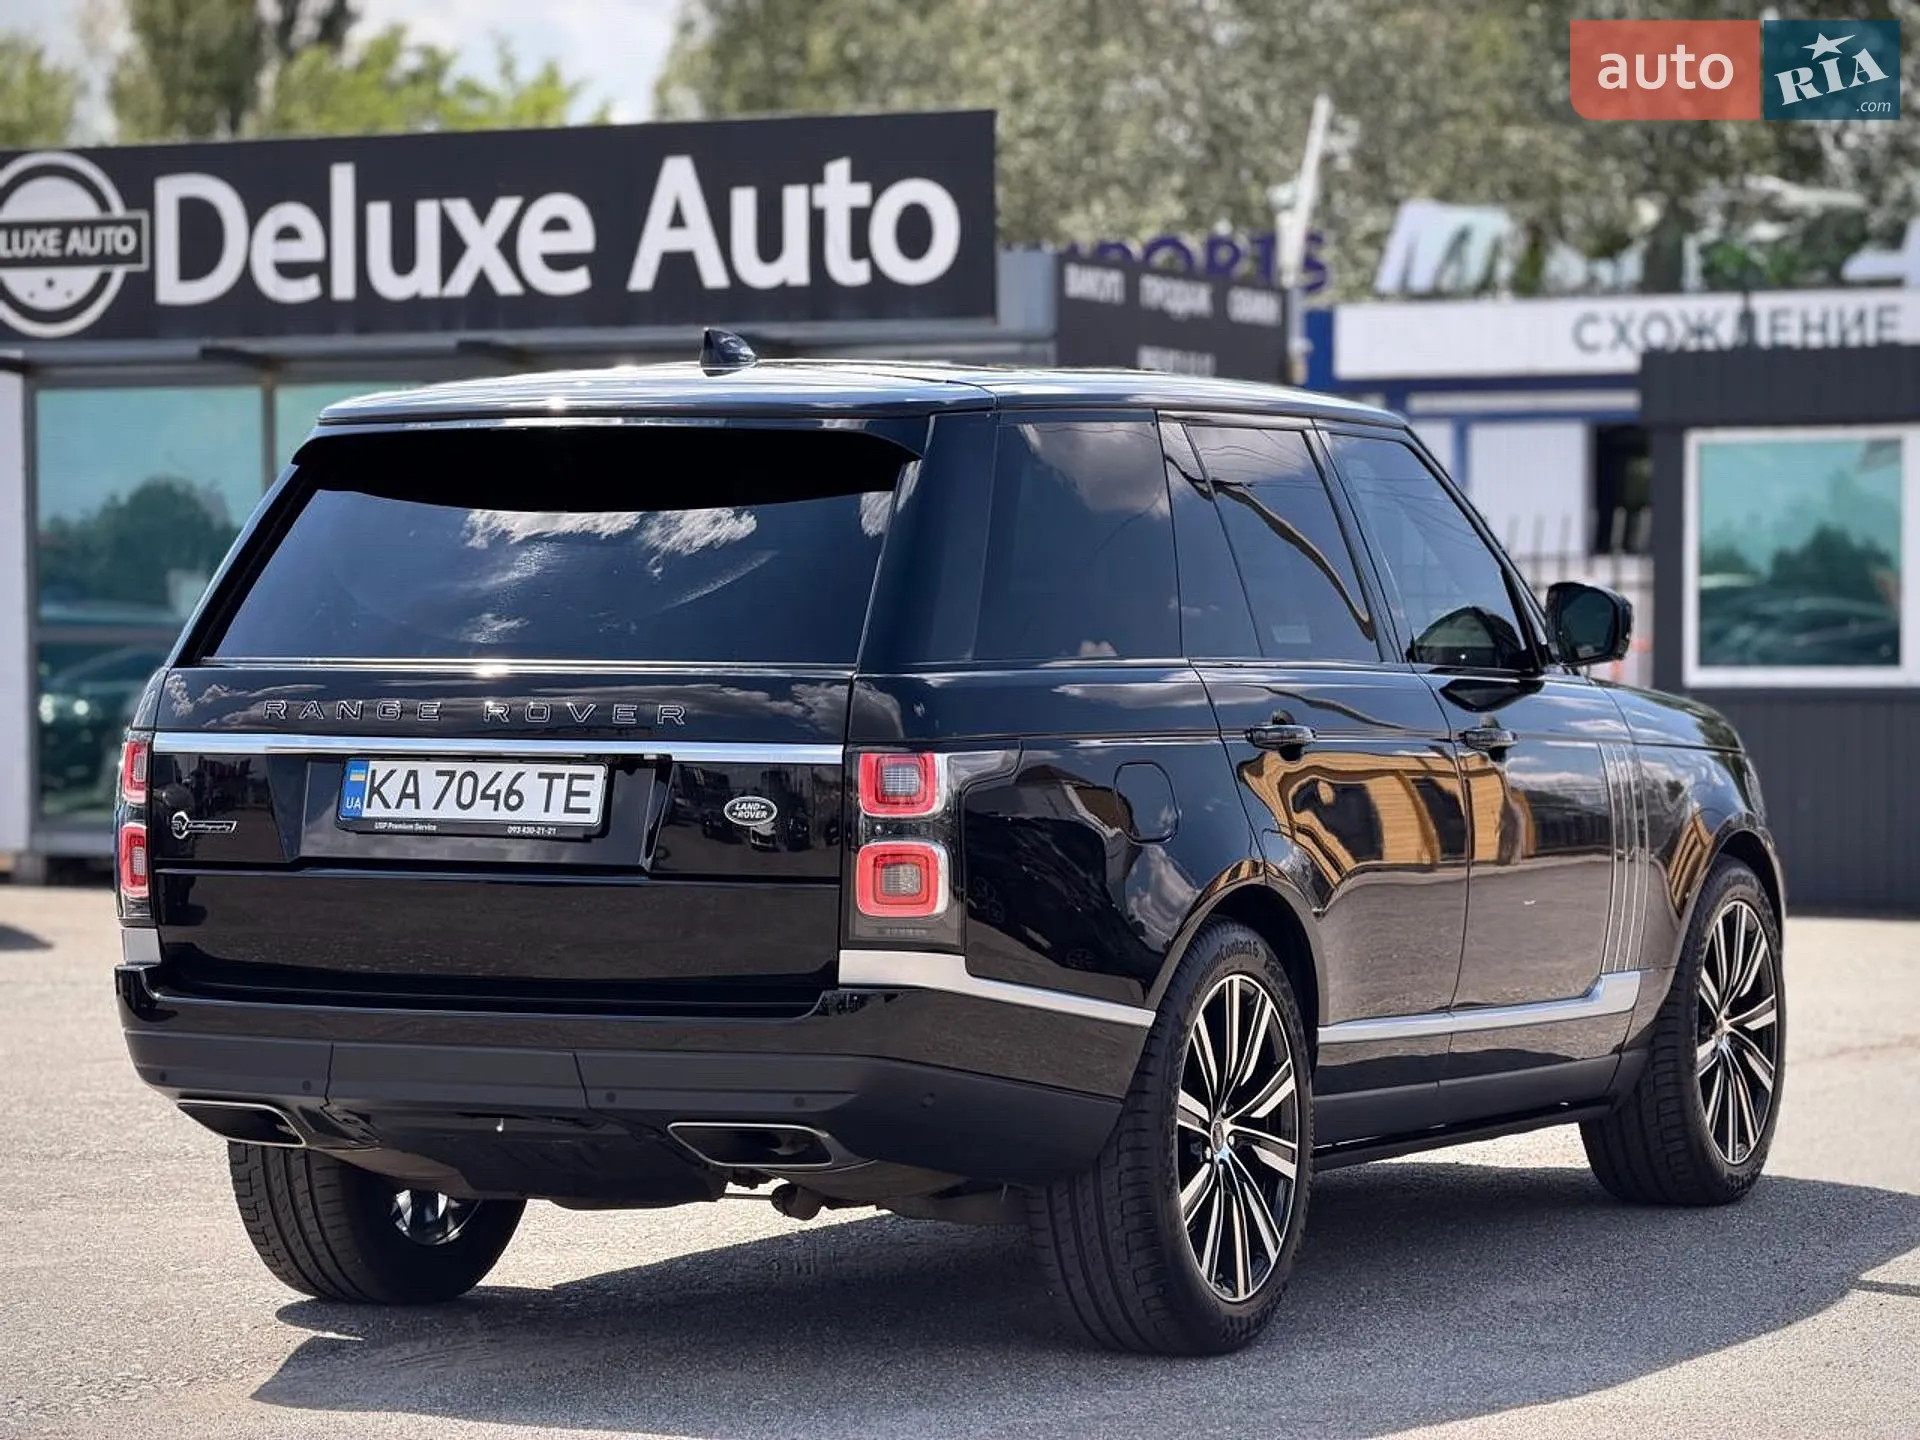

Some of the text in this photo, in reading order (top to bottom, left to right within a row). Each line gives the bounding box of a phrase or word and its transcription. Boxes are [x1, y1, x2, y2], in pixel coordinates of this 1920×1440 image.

[66, 225, 137, 256] AUTO
[154, 155, 960, 306] Deluxe Auto
[262, 699, 687, 725] RANGE ROVER
[345, 796, 362, 809] UA
[365, 768, 596, 814] KA 7046 TE
[388, 822, 414, 831] Premium
[414, 823, 437, 832] Service
